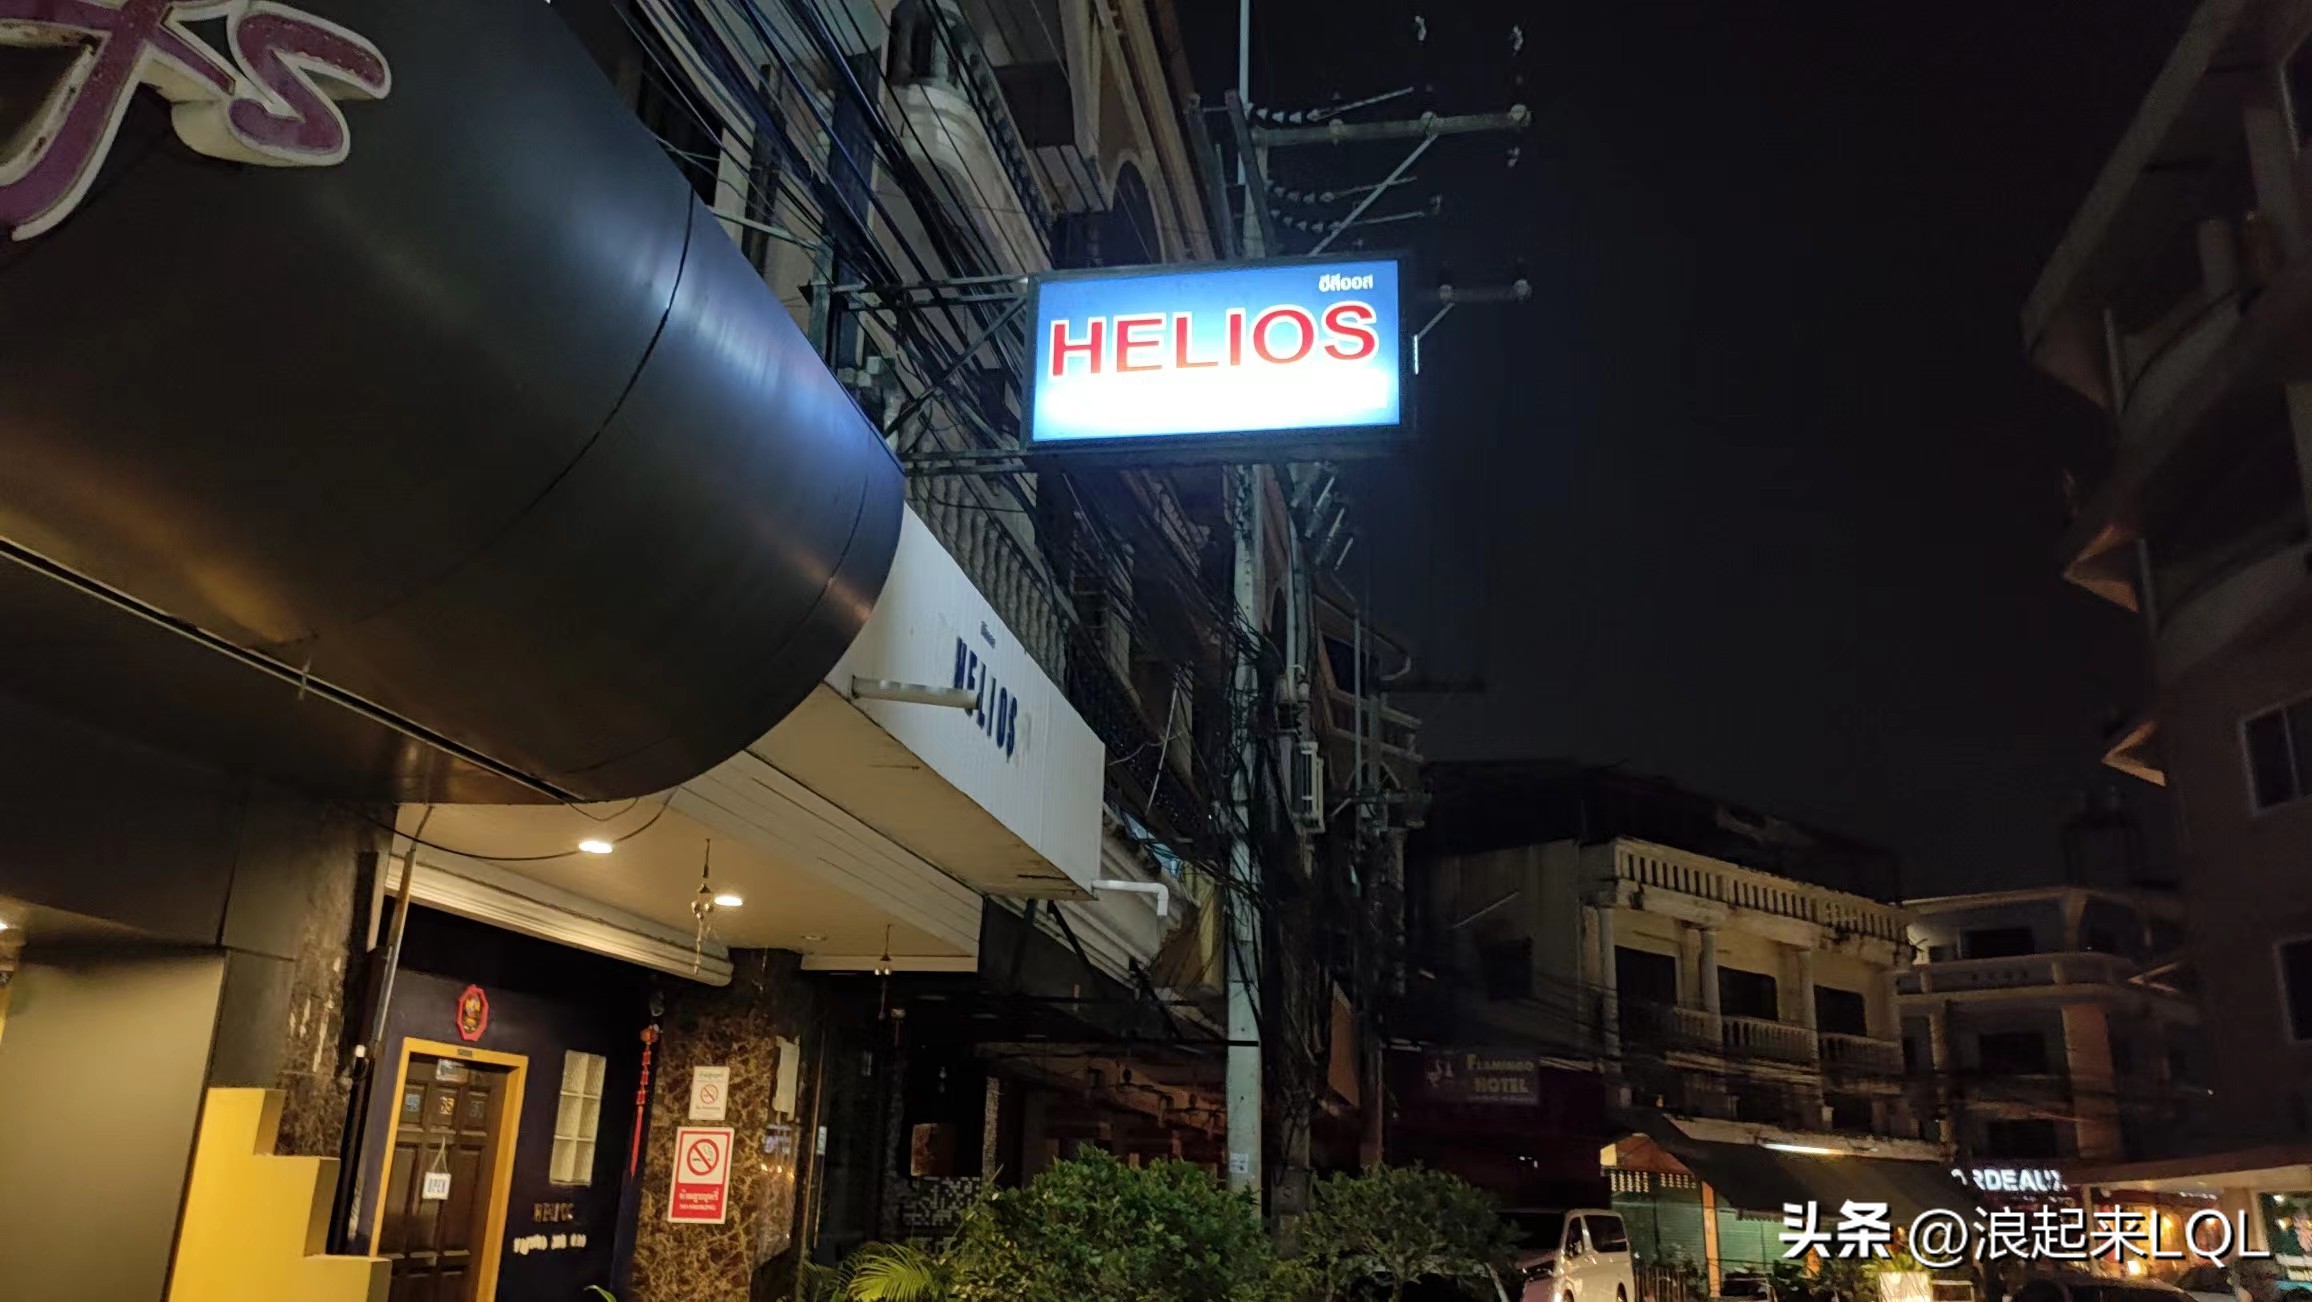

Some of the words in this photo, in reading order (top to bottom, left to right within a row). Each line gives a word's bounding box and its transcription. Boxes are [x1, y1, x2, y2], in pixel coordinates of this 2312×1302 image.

[1050, 302, 1379, 377] HELIOS
[954, 636, 1018, 762] HELIOS
[1474, 1077, 1529, 1093] HOTEL
